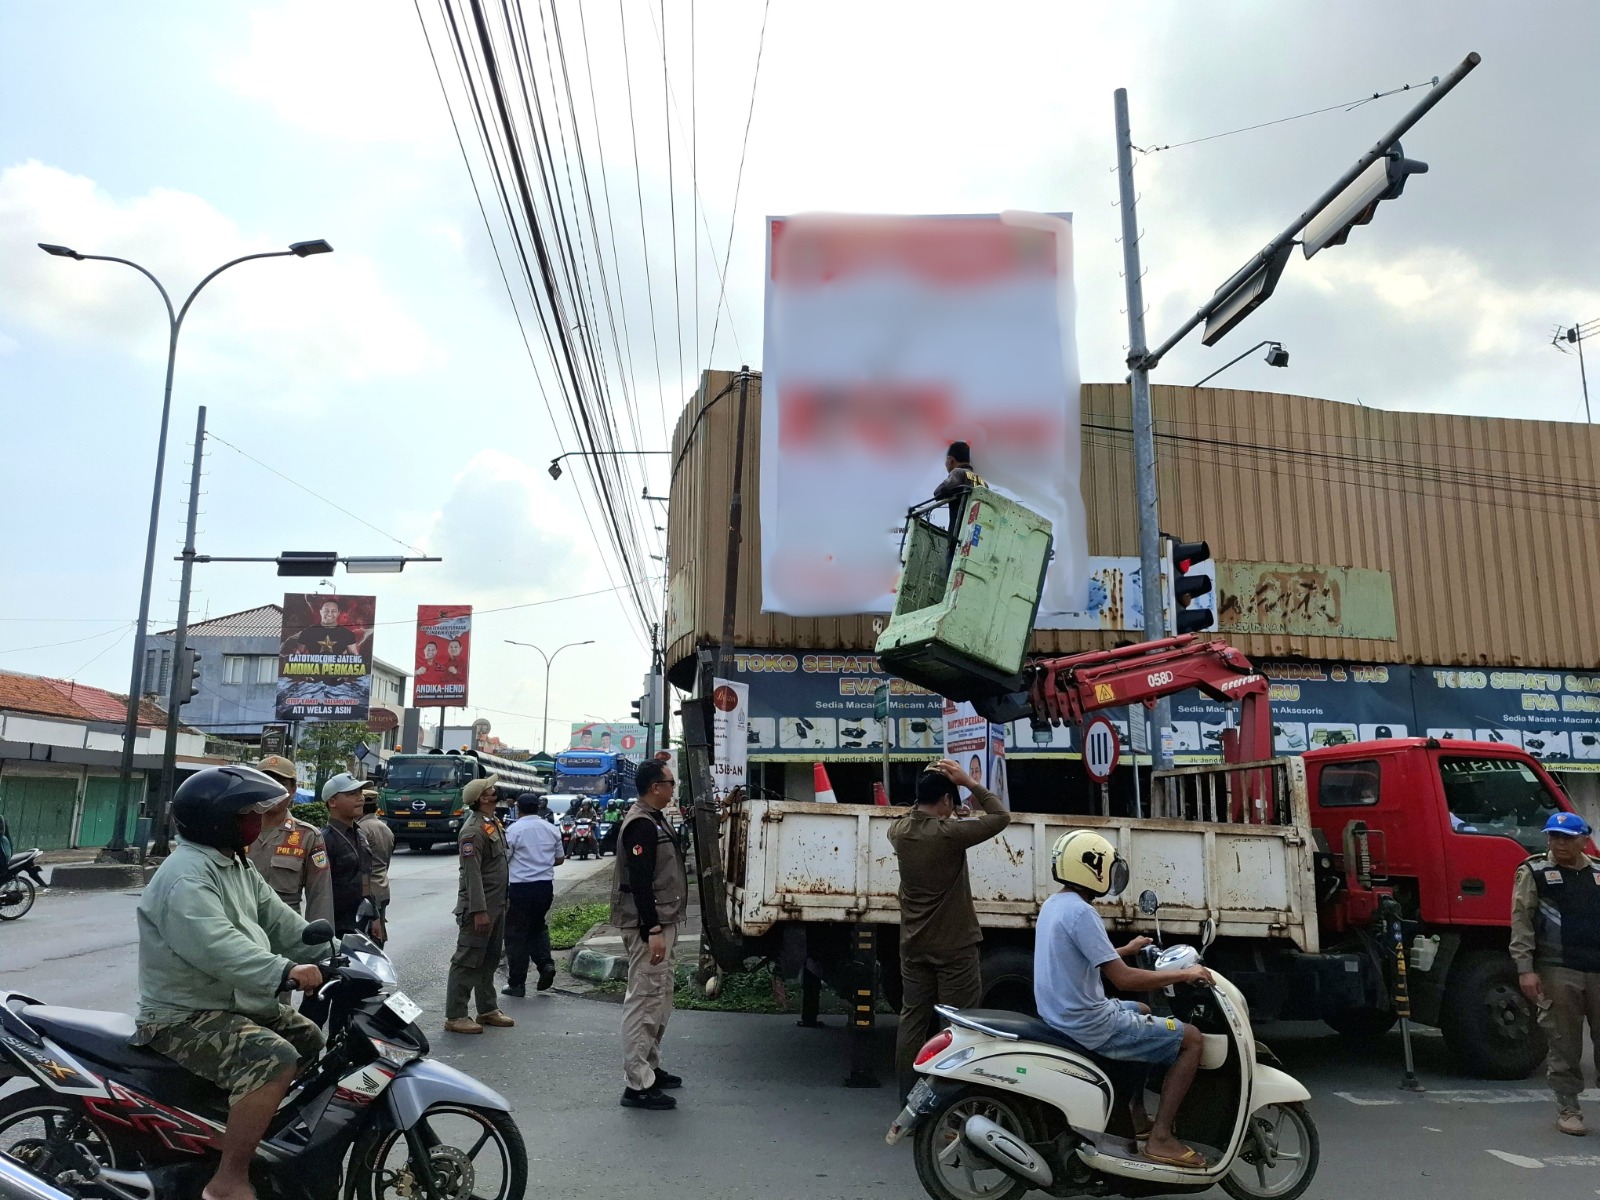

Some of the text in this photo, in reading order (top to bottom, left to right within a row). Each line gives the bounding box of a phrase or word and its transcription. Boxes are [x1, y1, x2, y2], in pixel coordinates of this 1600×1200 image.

[733, 653, 886, 674] TOKO SEPATU
[282, 663, 367, 675] ANDIKA PERKASA
[1261, 662, 1389, 684] ANDAL & TAS
[1433, 670, 1488, 689] TOKO
[1489, 672, 1561, 692] SEPATU
[416, 684, 465, 693] ANDIKA-HENDI
[839, 677, 883, 696] EVA
[1268, 684, 1301, 702] ARU
[815, 701, 844, 709] Sedia
[889, 701, 925, 709] Macam
[1521, 693, 1559, 711] EVA
[292, 706, 352, 714] ATI WELAS ASIH
[1178, 705, 1204, 713] Sedia
[1280, 706, 1324, 715] Aksesoris
[1503, 714, 1527, 722] Sedia
[1528, 715, 1557, 723] Macam
[1563, 716, 1593, 724] Macam
[625, 737, 631, 748] 1
[276, 846, 304, 856] POL PP
[356, 1086, 378, 1094] HONDA
